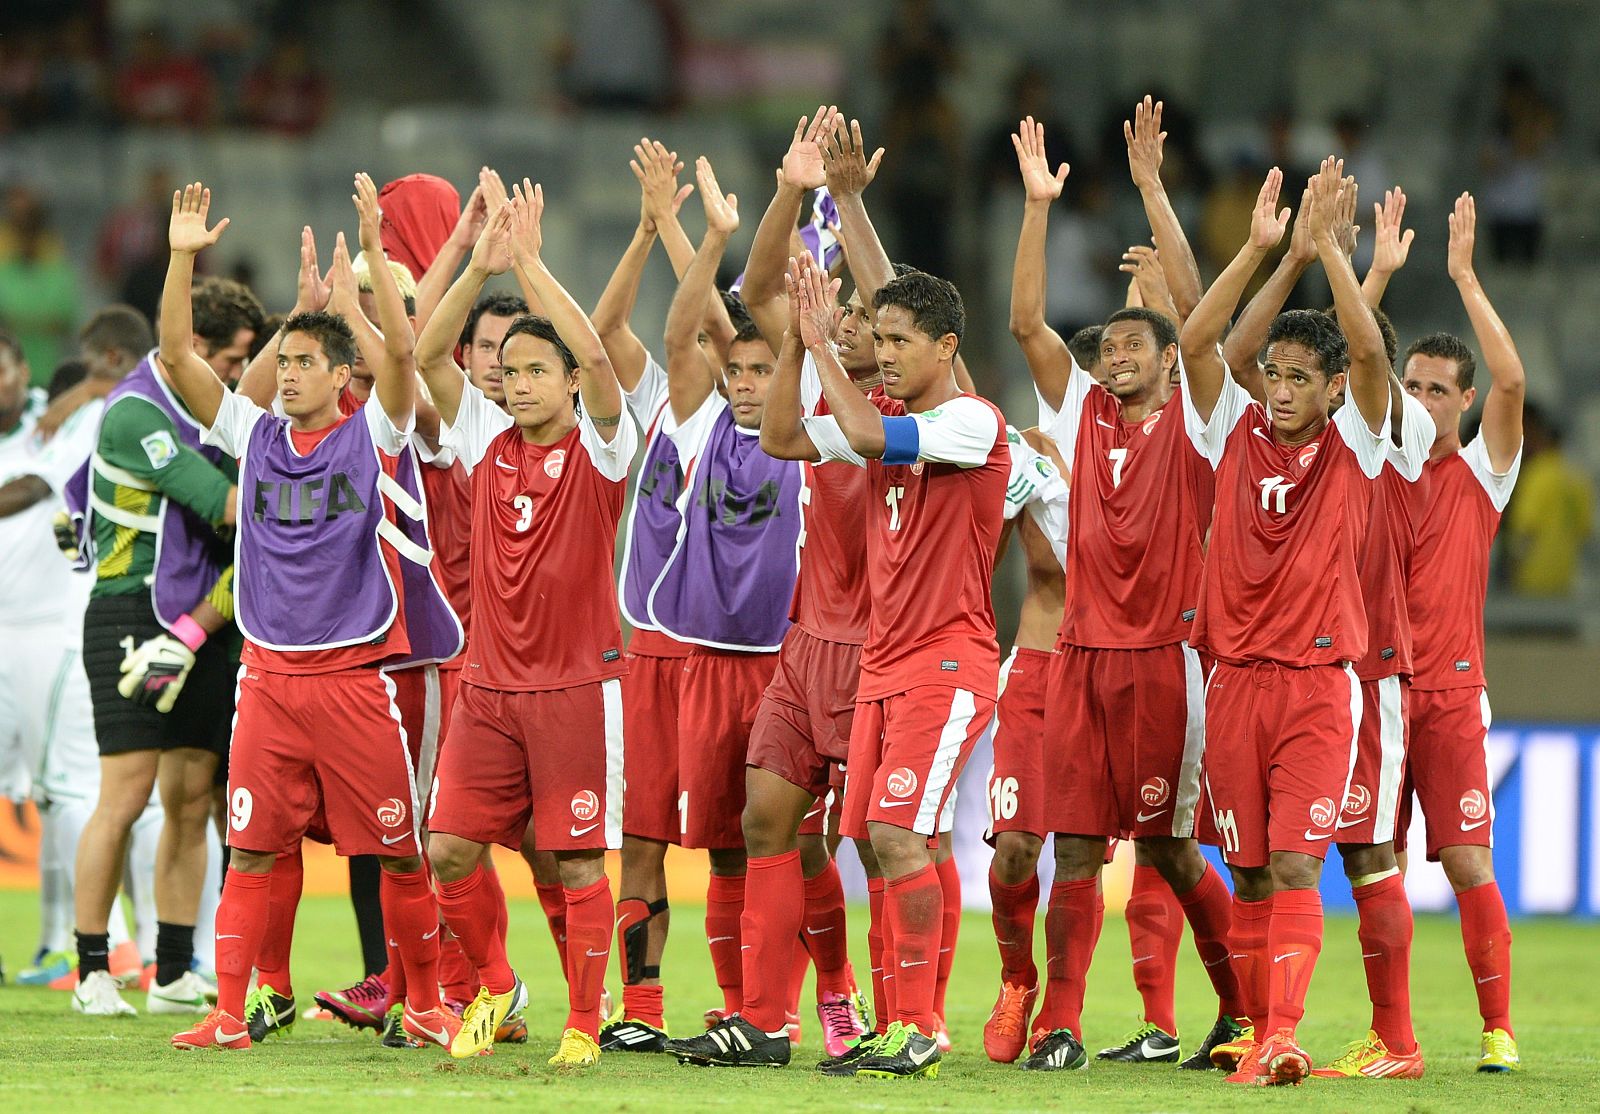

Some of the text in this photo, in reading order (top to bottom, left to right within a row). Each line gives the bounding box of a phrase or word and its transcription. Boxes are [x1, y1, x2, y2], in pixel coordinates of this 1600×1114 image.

[1108, 448, 1128, 490] 7
[253, 471, 368, 526] FIFA
[1258, 475, 1297, 514] 11
[513, 495, 534, 532] 3
[890, 783, 905, 792] FTF
[990, 776, 1020, 821] 16
[1144, 793, 1159, 801] FTF
[1345, 801, 1360, 809] FTF
[231, 787, 253, 832] 9
[381, 814, 397, 823] FTF
[575, 807, 591, 815] FTF
[1313, 813, 1328, 823] FTF
[1218, 809, 1240, 853] 11
